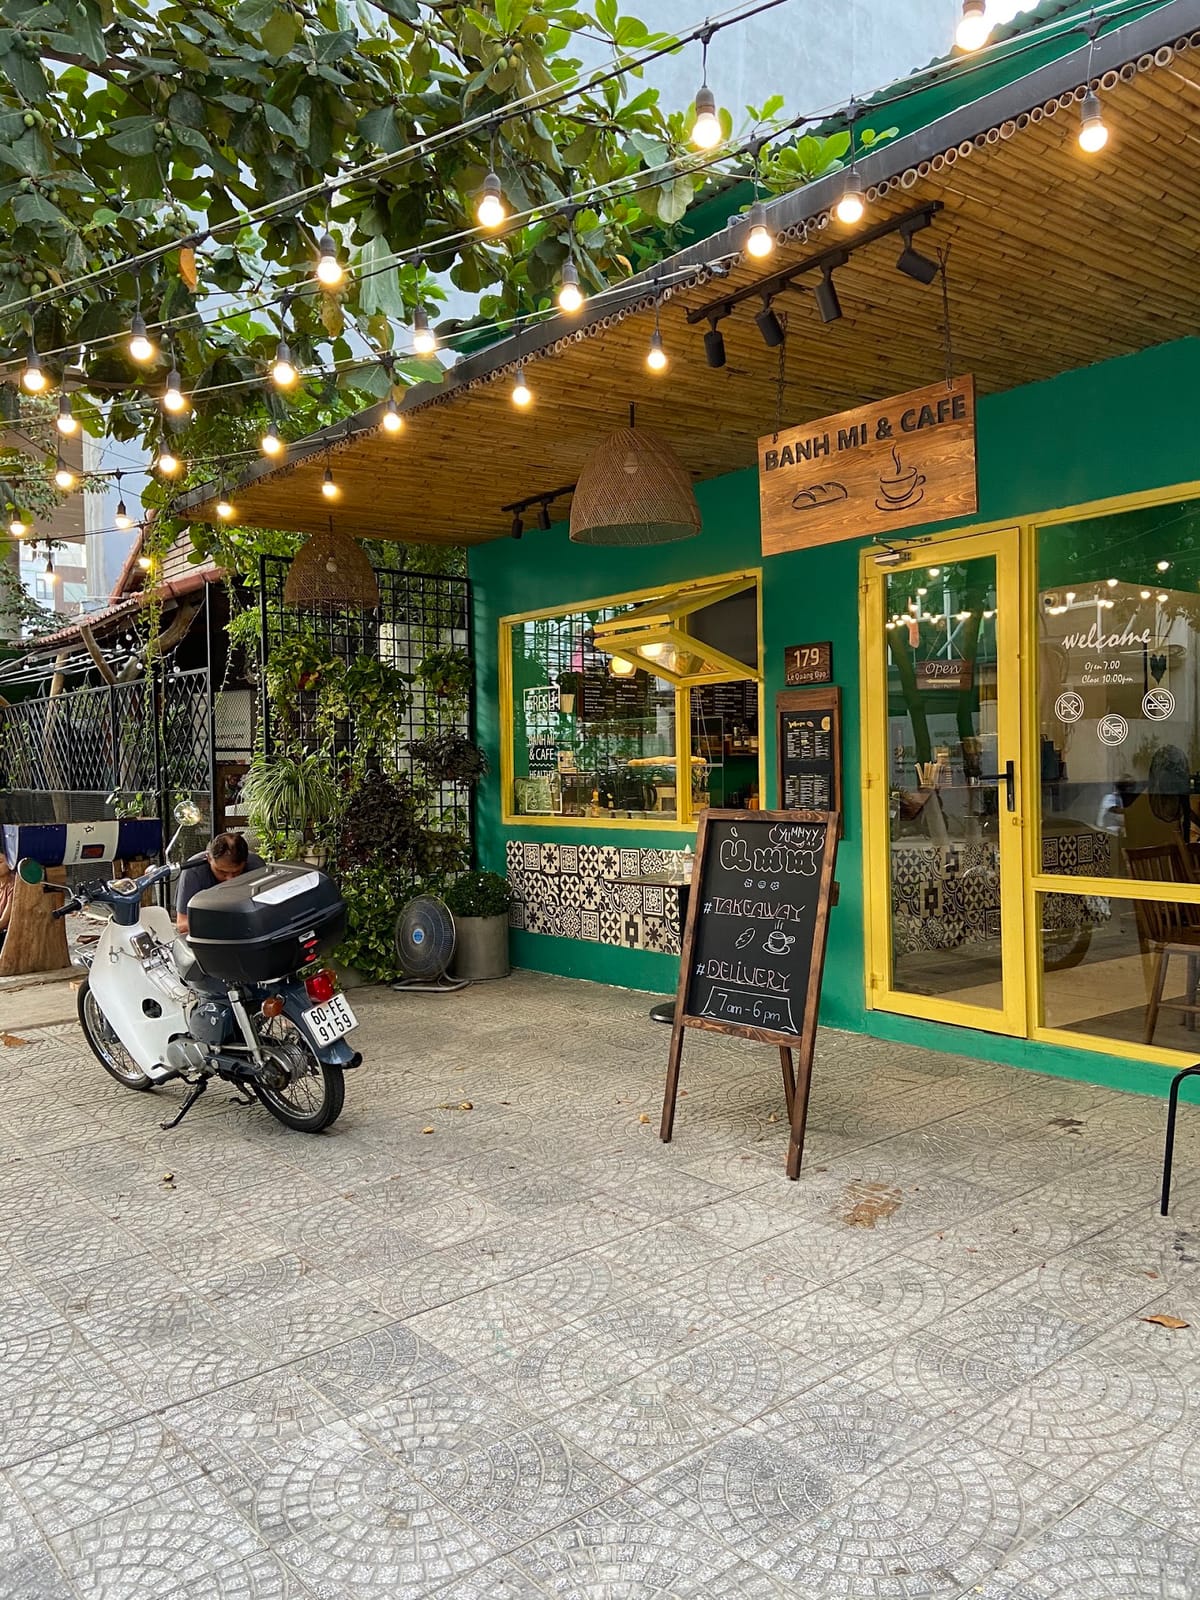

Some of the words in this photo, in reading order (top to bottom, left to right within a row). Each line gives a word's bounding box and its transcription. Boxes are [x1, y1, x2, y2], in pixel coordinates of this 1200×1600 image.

[765, 434, 830, 471] BANH
[837, 423, 867, 451] MI
[875, 416, 893, 440] &
[900, 394, 967, 433] CAFE
[1062, 622, 1151, 654] welcome
[793, 647, 820, 668] 179
[925, 662, 961, 678] Open
[529, 748, 535, 760] &
[535, 748, 555, 760] CAFE
[703, 896, 806, 921] #TAKEAWAY
[310, 997, 345, 1025] 60-FE
[319, 1013, 352, 1041] 9159
